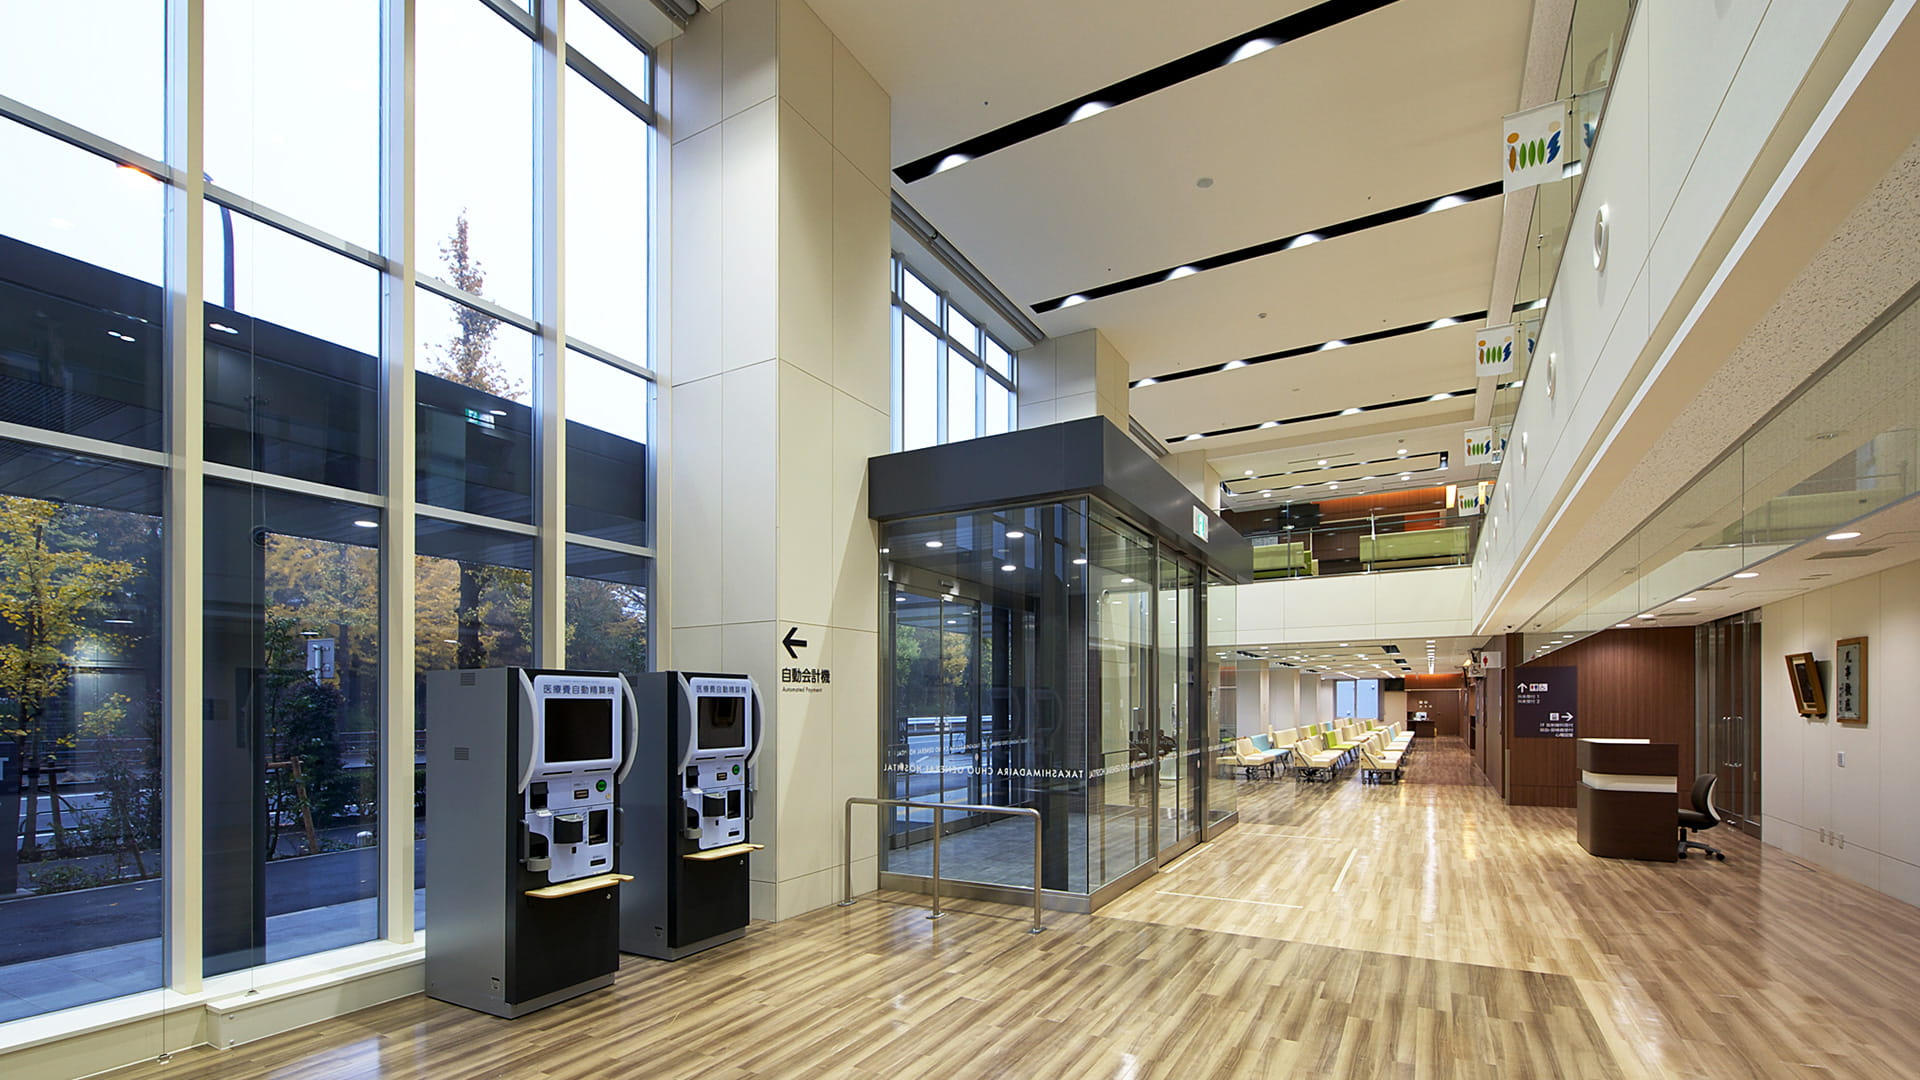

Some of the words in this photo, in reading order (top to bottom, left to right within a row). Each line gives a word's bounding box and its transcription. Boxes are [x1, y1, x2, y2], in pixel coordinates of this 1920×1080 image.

[781, 668, 831, 684] 自動会計機
[543, 684, 615, 696] 医療費自動精算機
